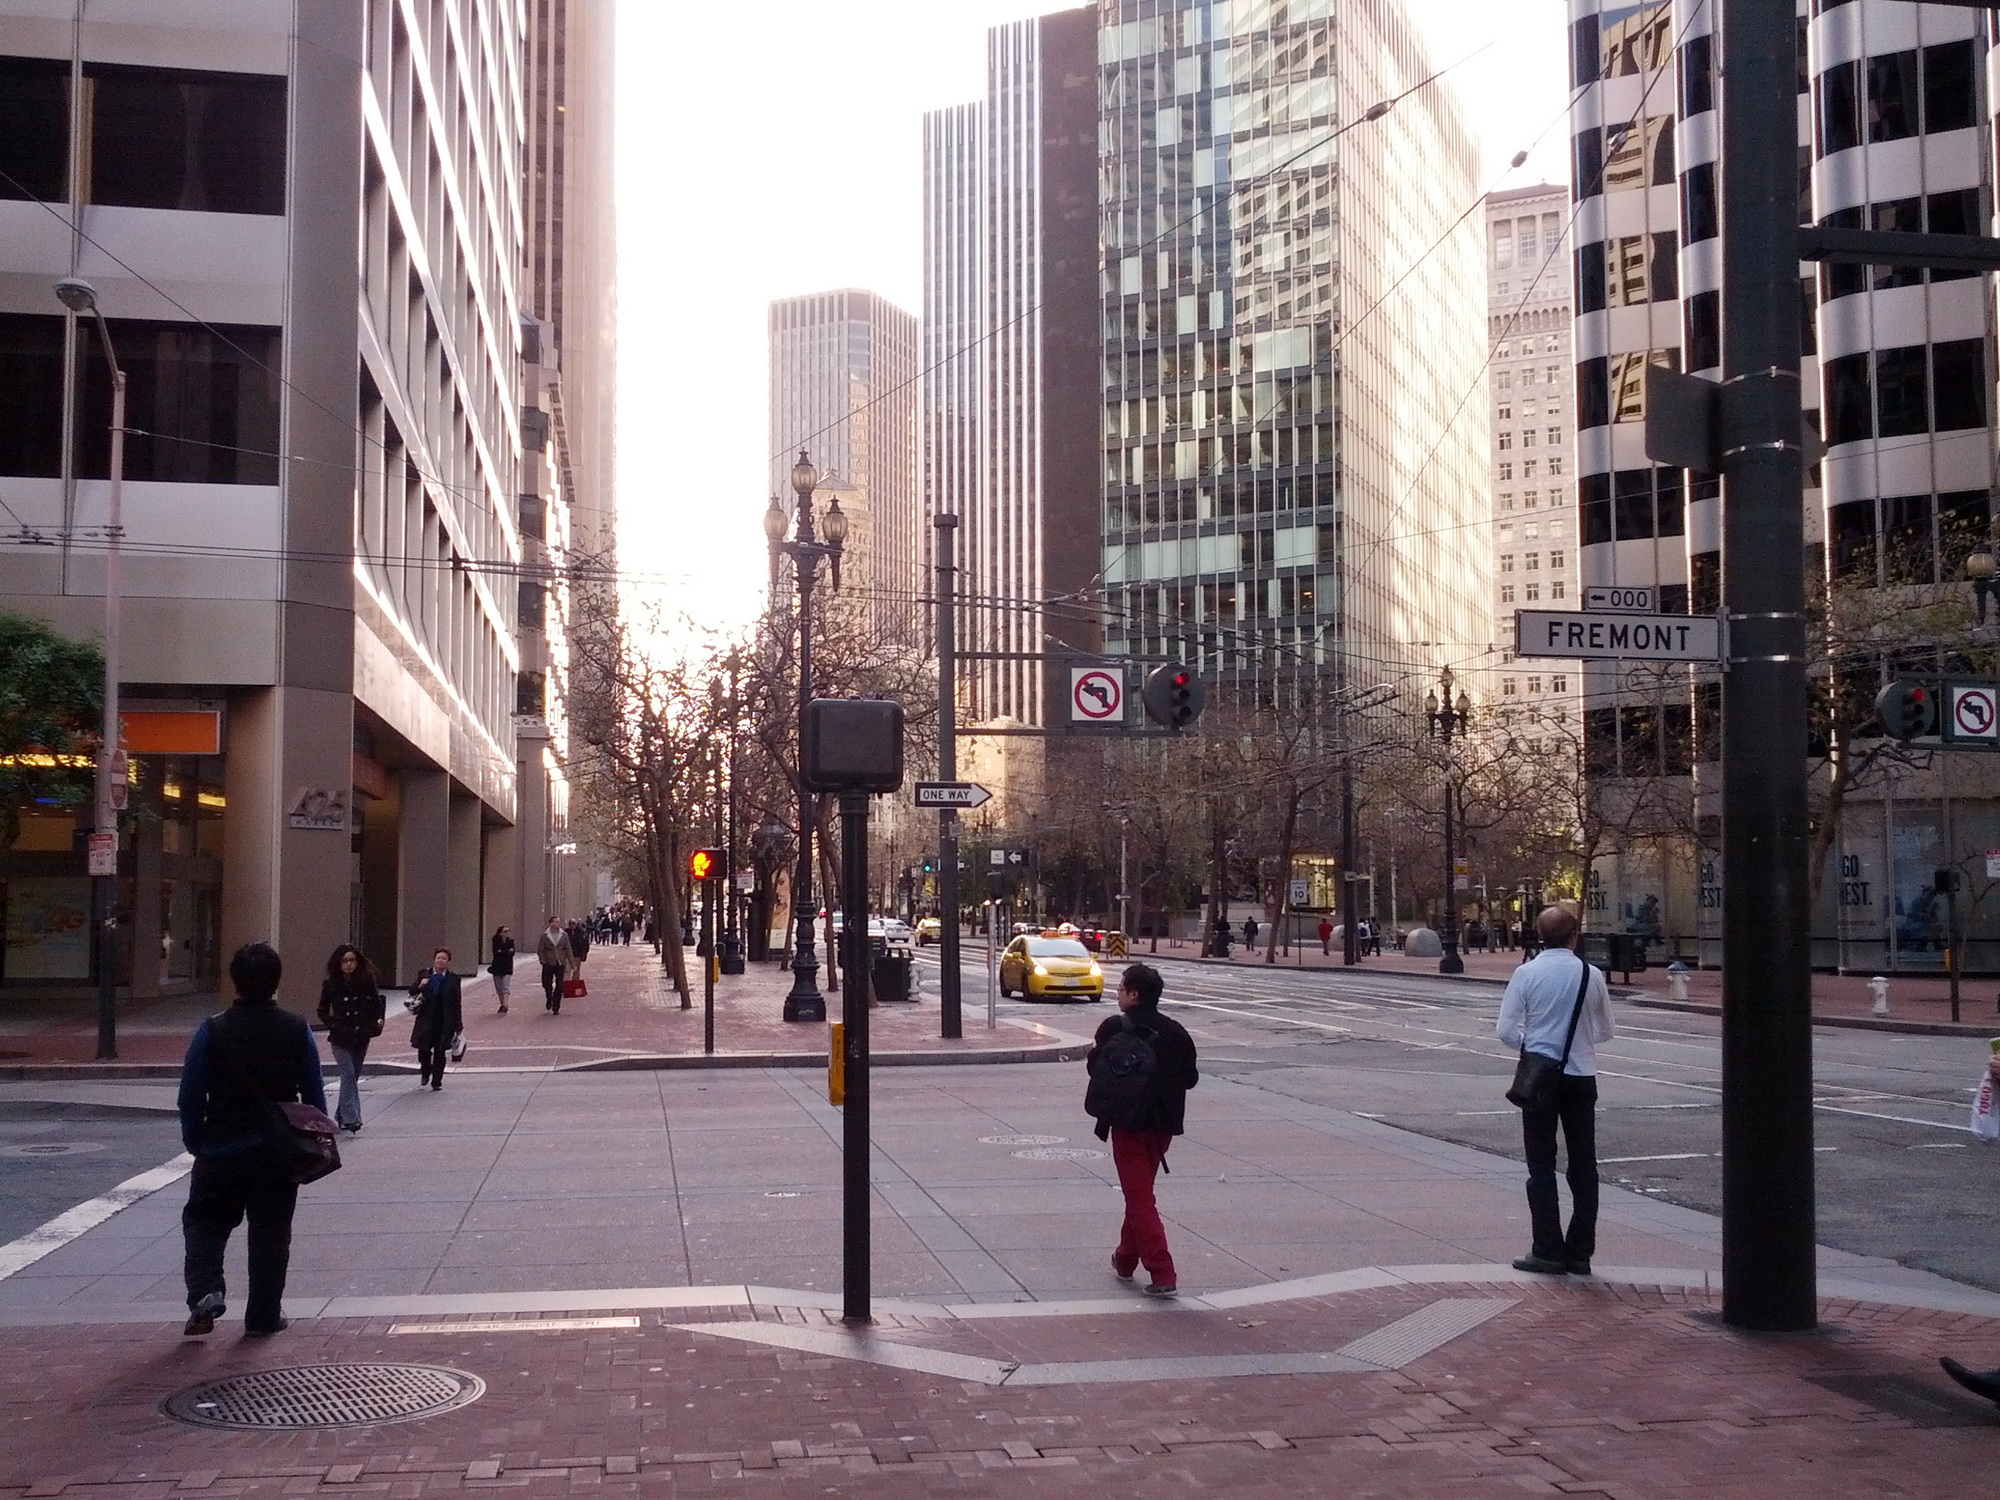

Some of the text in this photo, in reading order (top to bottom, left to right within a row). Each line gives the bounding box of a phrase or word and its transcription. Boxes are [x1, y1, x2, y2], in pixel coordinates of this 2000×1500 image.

[1611, 590, 1647, 607] 000
[1548, 621, 1690, 651] FREMONT
[923, 790, 970, 800] ONE WAY
[1842, 854, 1859, 878] GO
[1294, 890, 1305, 899] 10
